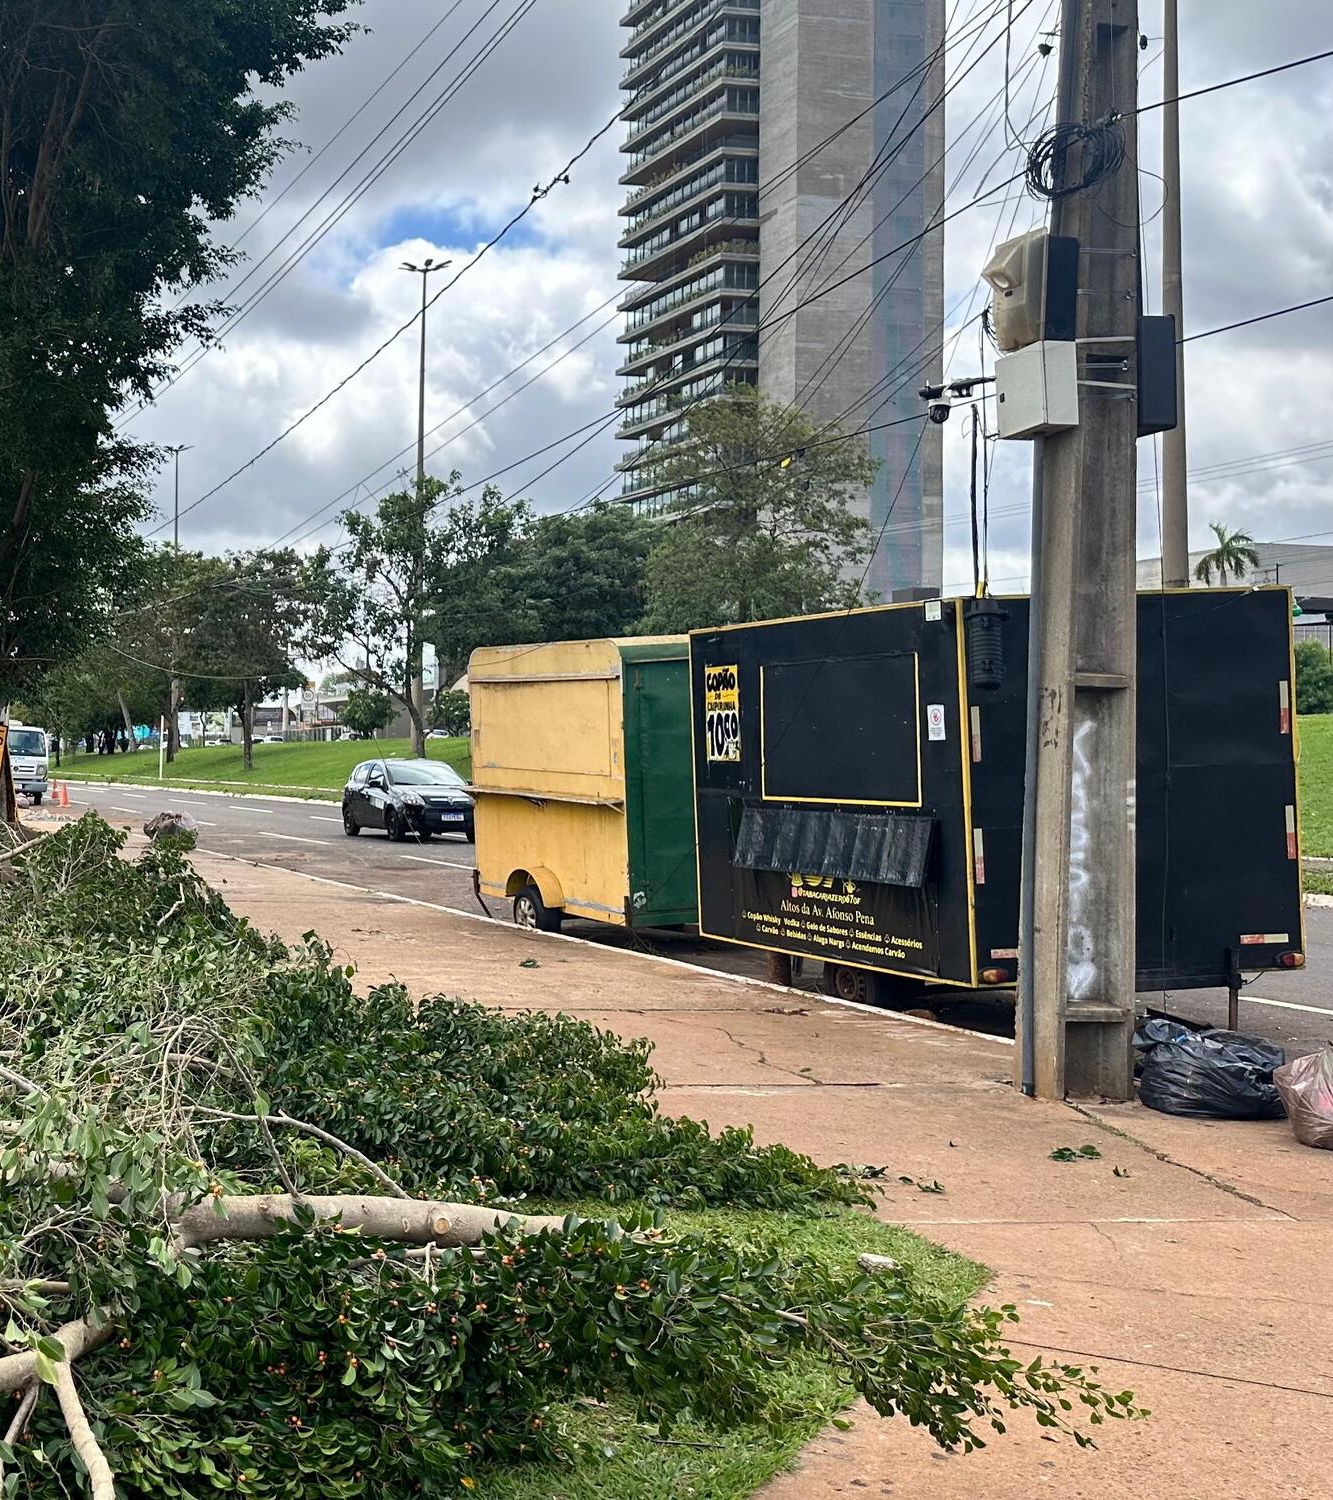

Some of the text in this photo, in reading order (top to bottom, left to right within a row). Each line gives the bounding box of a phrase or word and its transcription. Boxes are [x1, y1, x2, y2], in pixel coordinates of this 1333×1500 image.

[707, 668, 735, 692] COPÃO
[780, 899, 874, 926] Altos da Av. Afonso Pena
[761, 925, 779, 935] Carvão
[786, 929, 806, 940] Bebidas
[851, 941, 884, 955] Acendemos
[884, 947, 906, 959] Carvão
[763, 914, 781, 926] Whisky
[784, 917, 800, 927] Vodka
[819, 923, 826, 932] de
[826, 925, 848, 936] Sabores
[855, 929, 882, 942] Essências
[891, 935, 923, 950] Acessórios
